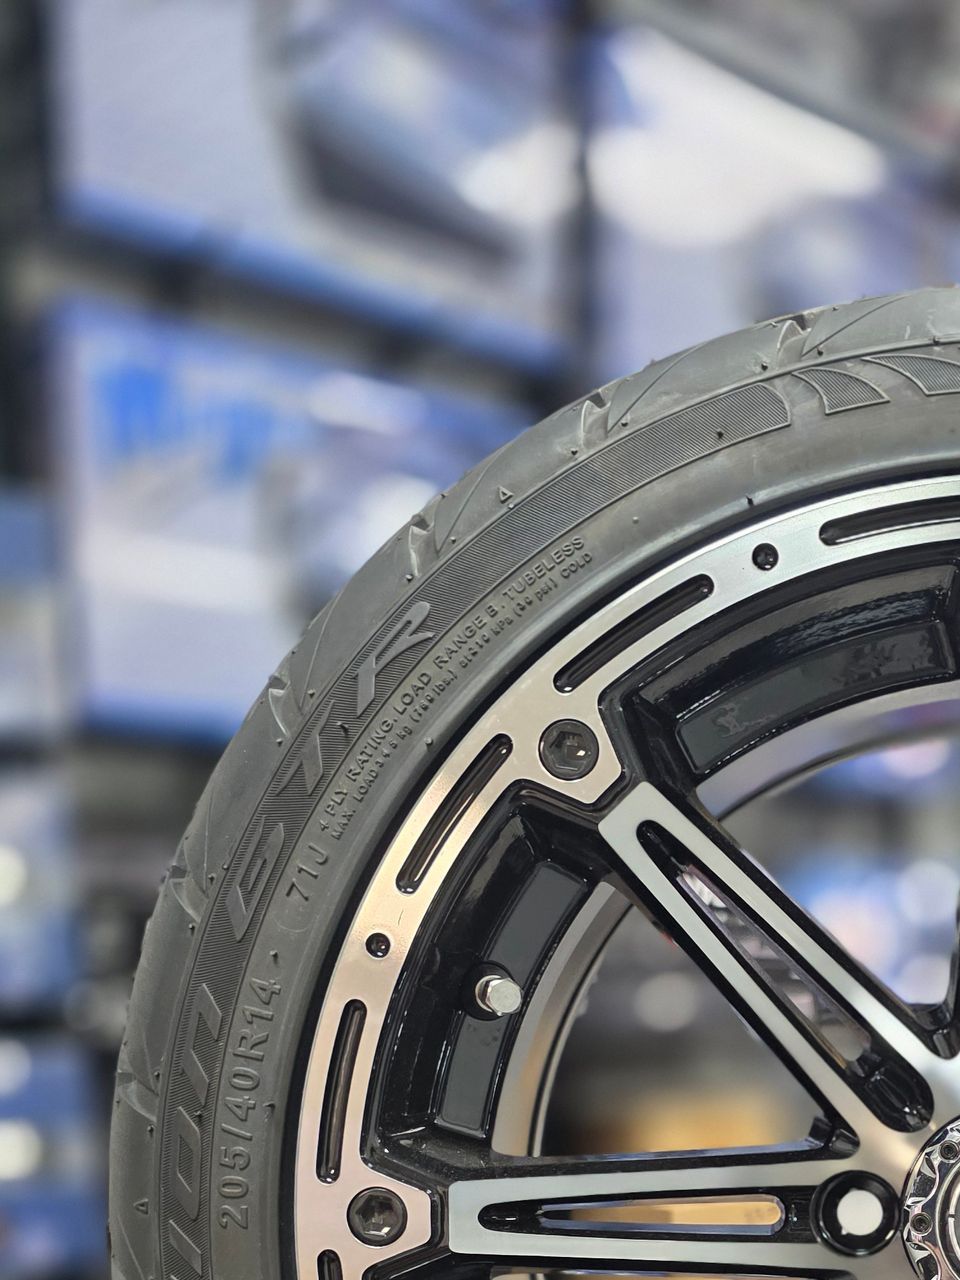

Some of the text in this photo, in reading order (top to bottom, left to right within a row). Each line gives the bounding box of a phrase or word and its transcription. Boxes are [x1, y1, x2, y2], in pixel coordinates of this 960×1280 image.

[225, 600, 435, 943] GTR
[324, 786, 349, 817] PLY
[393, 670, 433, 715] LOAD
[432, 614, 487, 669] RANGE
[501, 535, 585, 603] TUBELESS
[352, 768, 379, 802] LOAD
[558, 550, 592, 578] COLD
[217, 842, 330, 1231] 205/40R14 71J
